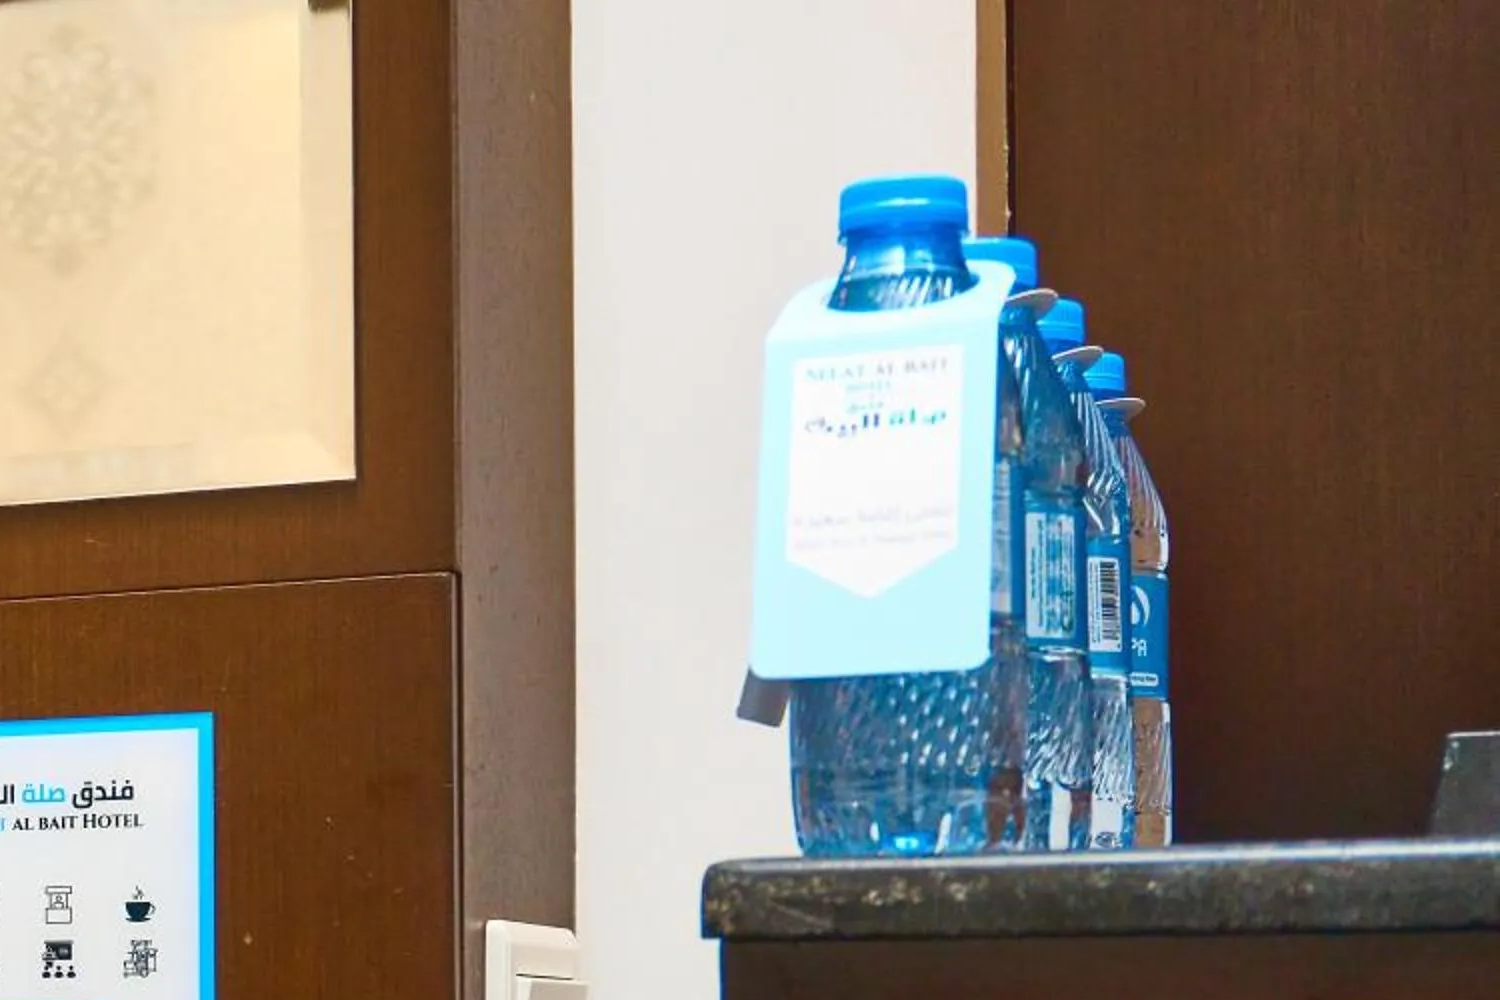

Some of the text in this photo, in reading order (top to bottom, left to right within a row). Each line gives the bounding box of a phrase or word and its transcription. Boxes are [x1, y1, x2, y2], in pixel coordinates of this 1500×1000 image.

[21, 783, 68, 803] صلة
[71, 779, 135, 809] فندق
[11, 816, 35, 831] AL
[38, 815, 79, 831] BAIT
[83, 812, 145, 829] HOTEL
